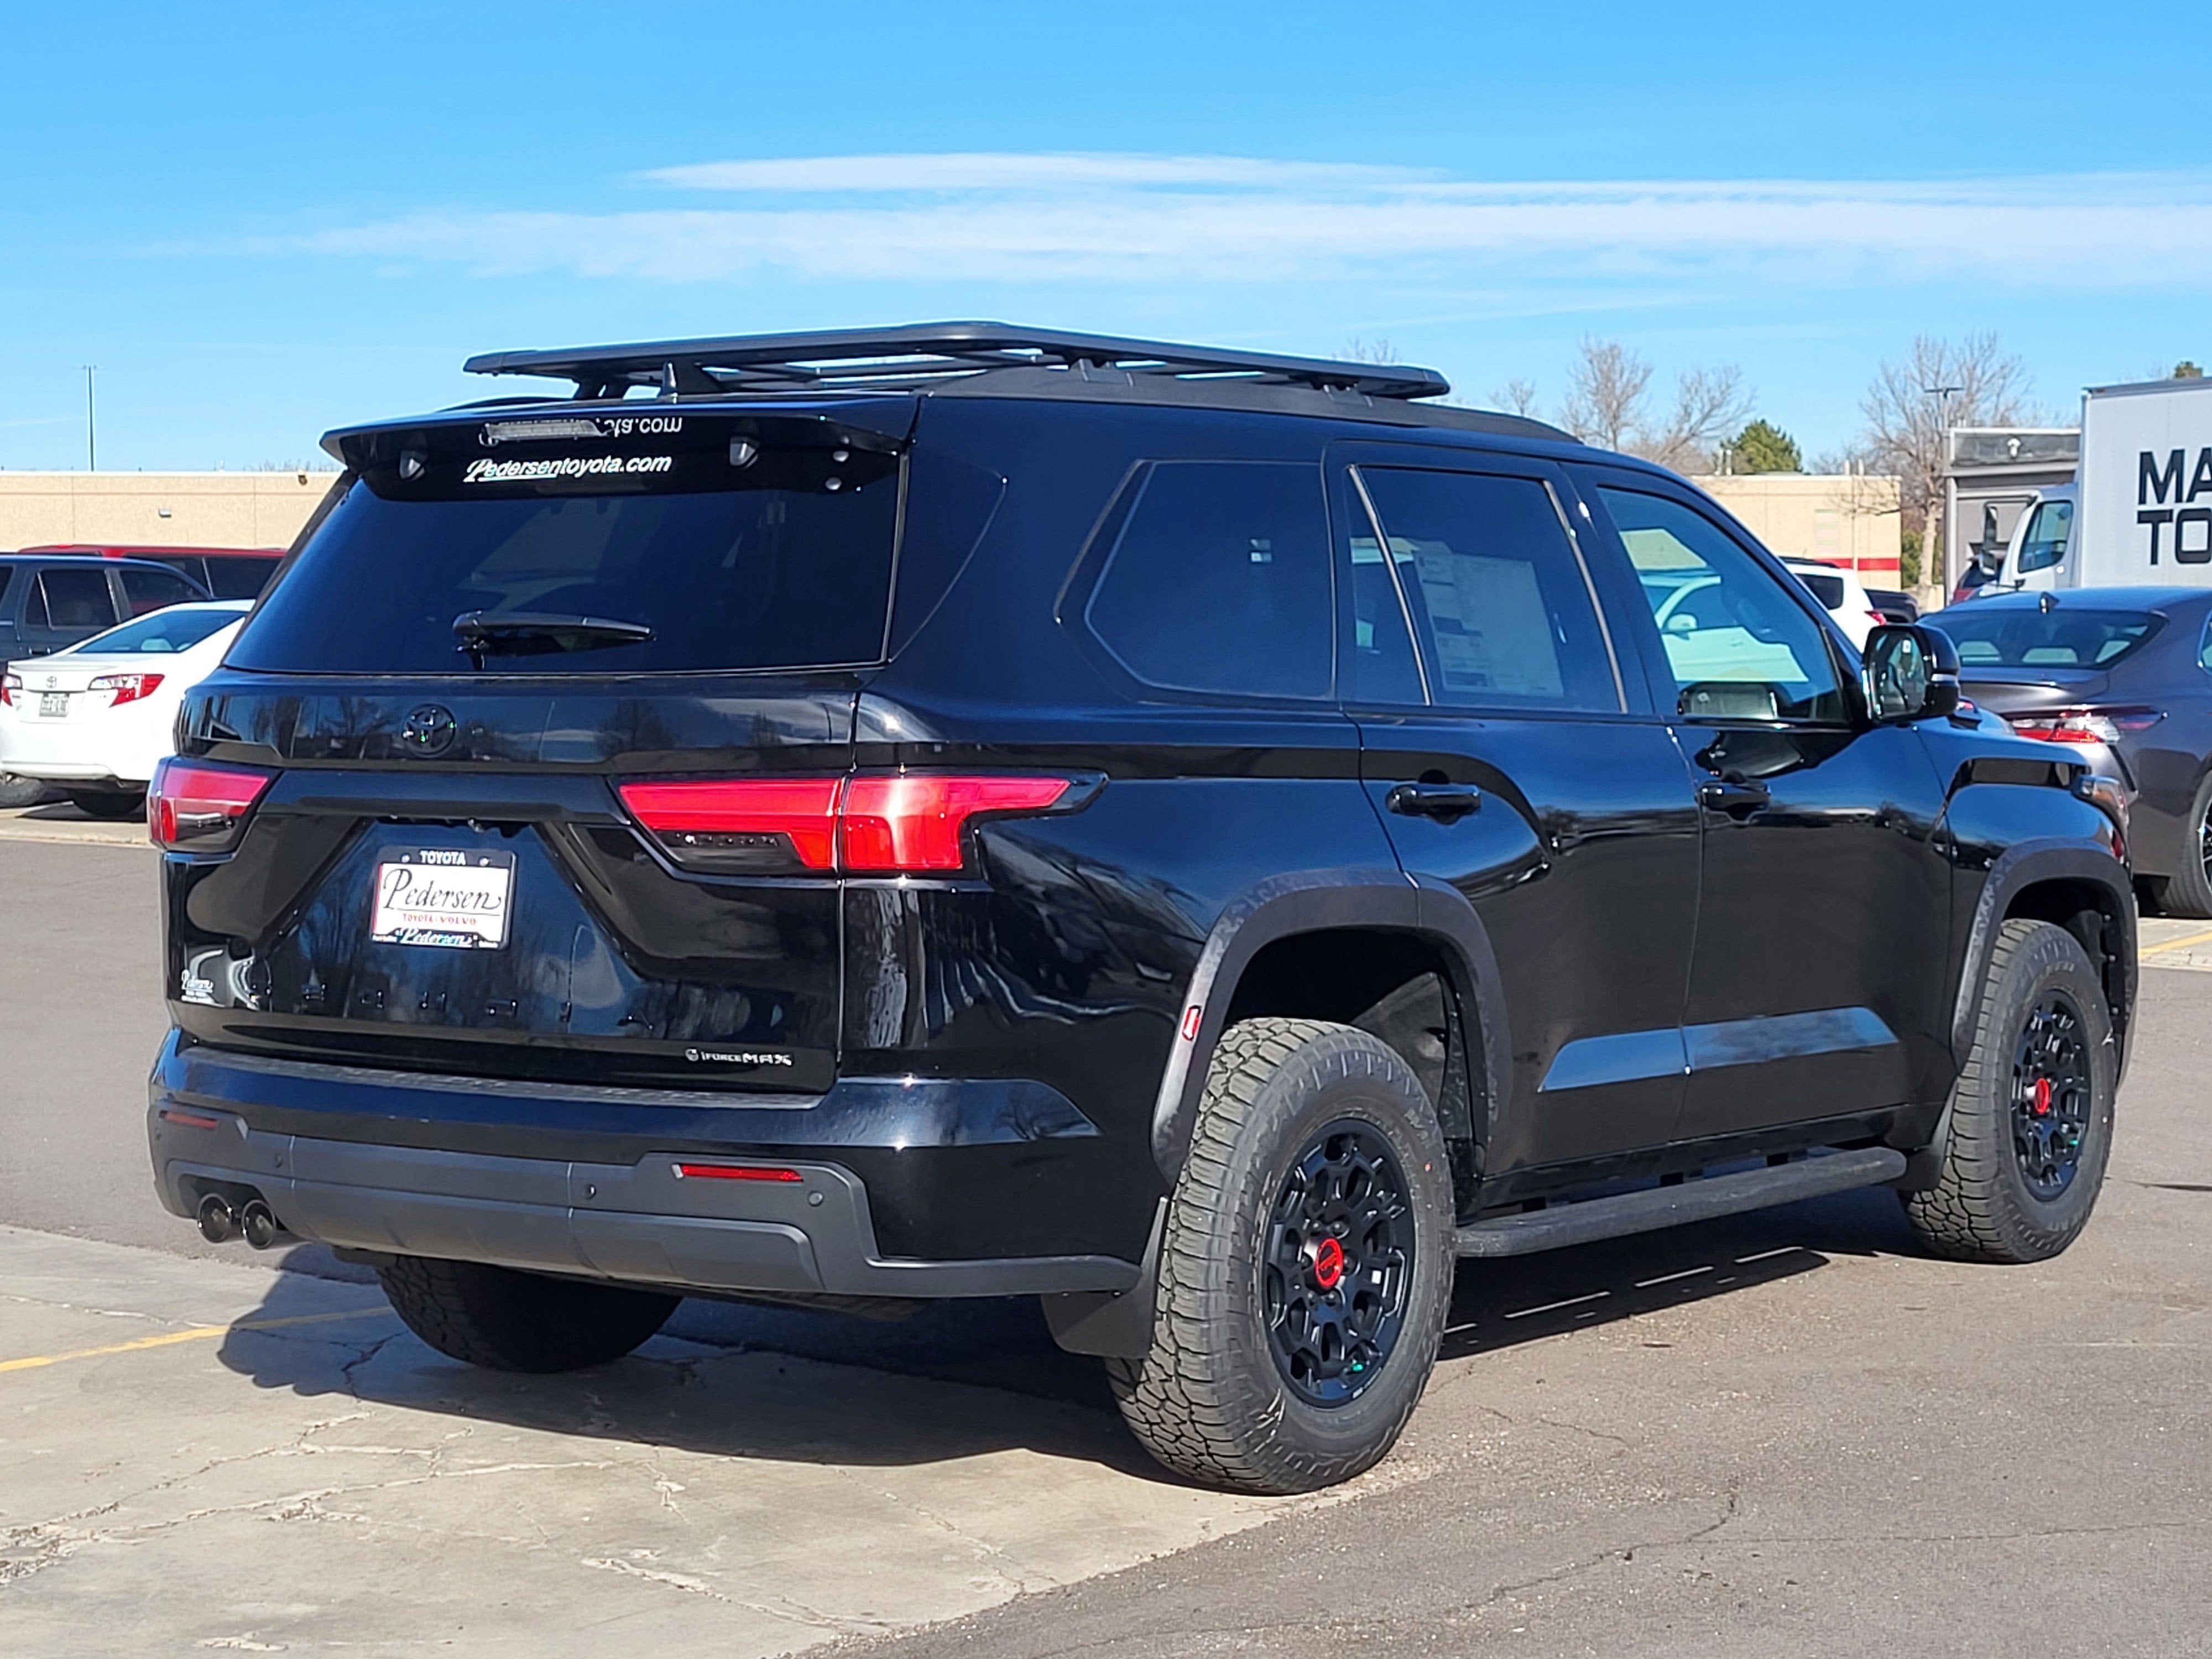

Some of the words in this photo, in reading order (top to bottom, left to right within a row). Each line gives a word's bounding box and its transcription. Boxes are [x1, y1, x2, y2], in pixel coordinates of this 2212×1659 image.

[463, 455, 671, 483] Pedersentoyota.com
[2138, 447, 2212, 504] MA
[2137, 508, 2212, 565] TO
[420, 851, 466, 865] TOYOTA
[383, 869, 502, 910] Pedersen
